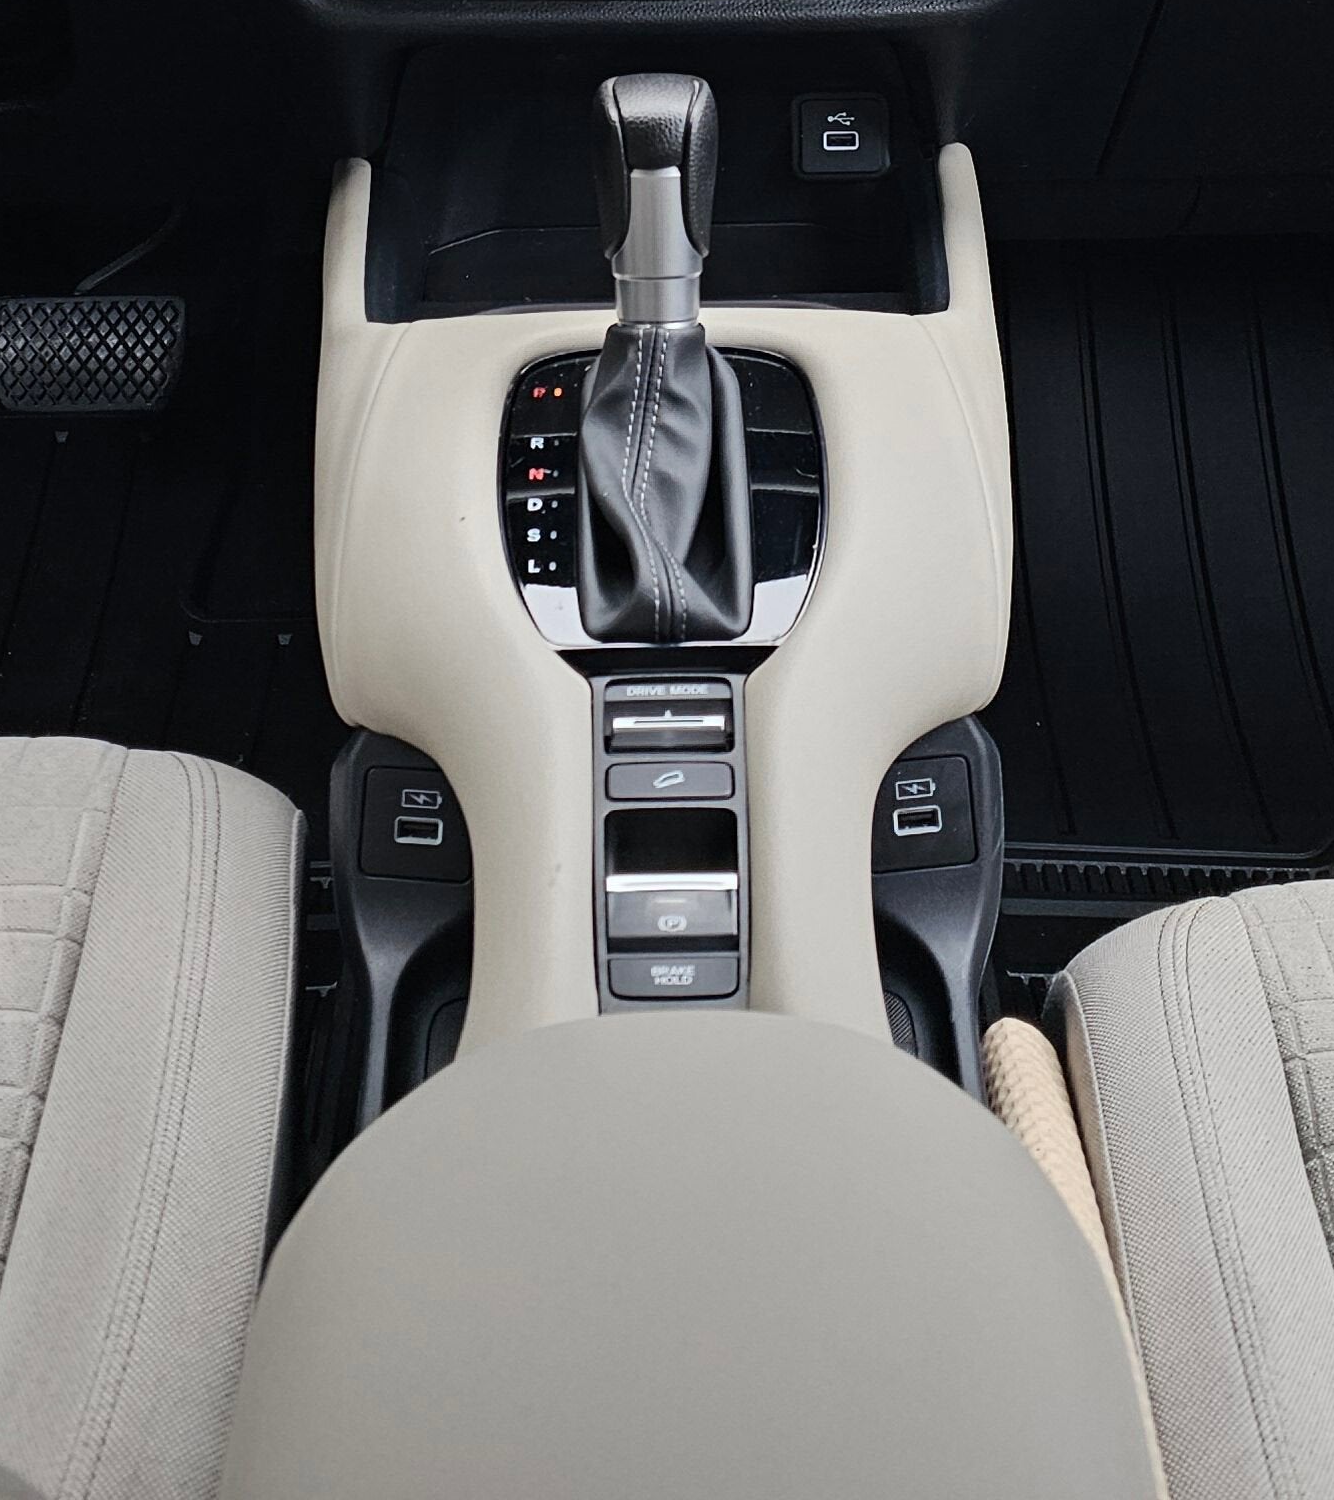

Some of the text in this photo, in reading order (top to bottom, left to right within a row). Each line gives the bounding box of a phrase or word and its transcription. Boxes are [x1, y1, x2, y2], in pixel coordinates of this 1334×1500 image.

[533, 387, 546, 398] P
[530, 437, 545, 449] R
[528, 468, 544, 480] N
[527, 498, 543, 512] D
[527, 528, 541, 542] S
[527, 559, 541, 574] L
[626, 684, 708, 697] DRIVE MODE
[650, 965, 696, 977] BRAKE
[654, 976, 693, 986] HOLD
